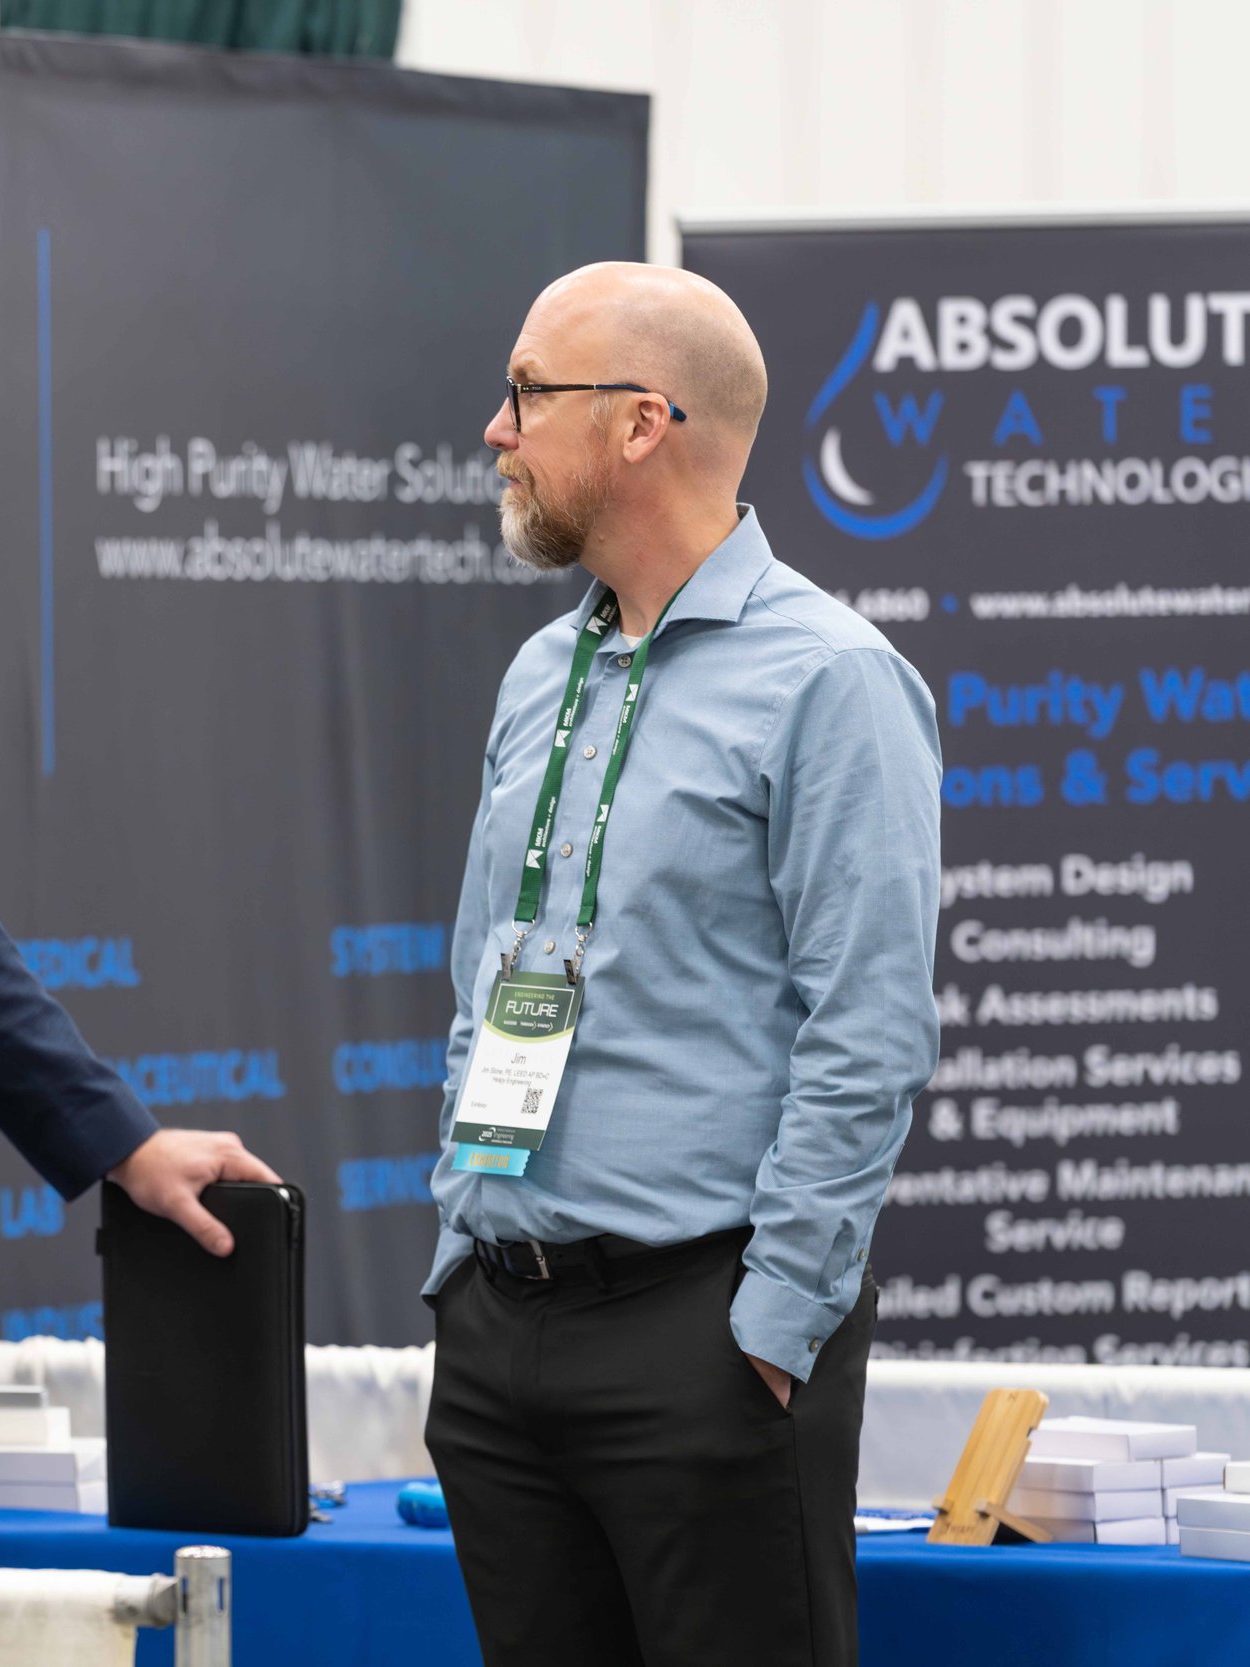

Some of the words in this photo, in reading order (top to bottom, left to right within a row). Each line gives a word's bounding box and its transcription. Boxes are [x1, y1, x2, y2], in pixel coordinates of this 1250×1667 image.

[872, 292, 1250, 373] ABSOLUT
[95, 435, 184, 512] High
[188, 436, 287, 515] Purity
[288, 440, 393, 502] Water
[948, 667, 1124, 741] Purity
[1061, 748, 1109, 806] &
[1059, 852, 1194, 904] Design
[951, 915, 1157, 968] Consulting
[505, 1000, 559, 1017] FUTURE
[975, 981, 1219, 1027] Assessments
[510, 1052, 527, 1064] Jim
[1083, 1042, 1242, 1087] Services
[928, 1096, 964, 1142] &
[970, 1095, 1180, 1148] Equipment
[984, 1208, 1126, 1254] Service
[966, 1273, 1115, 1318] Custom
